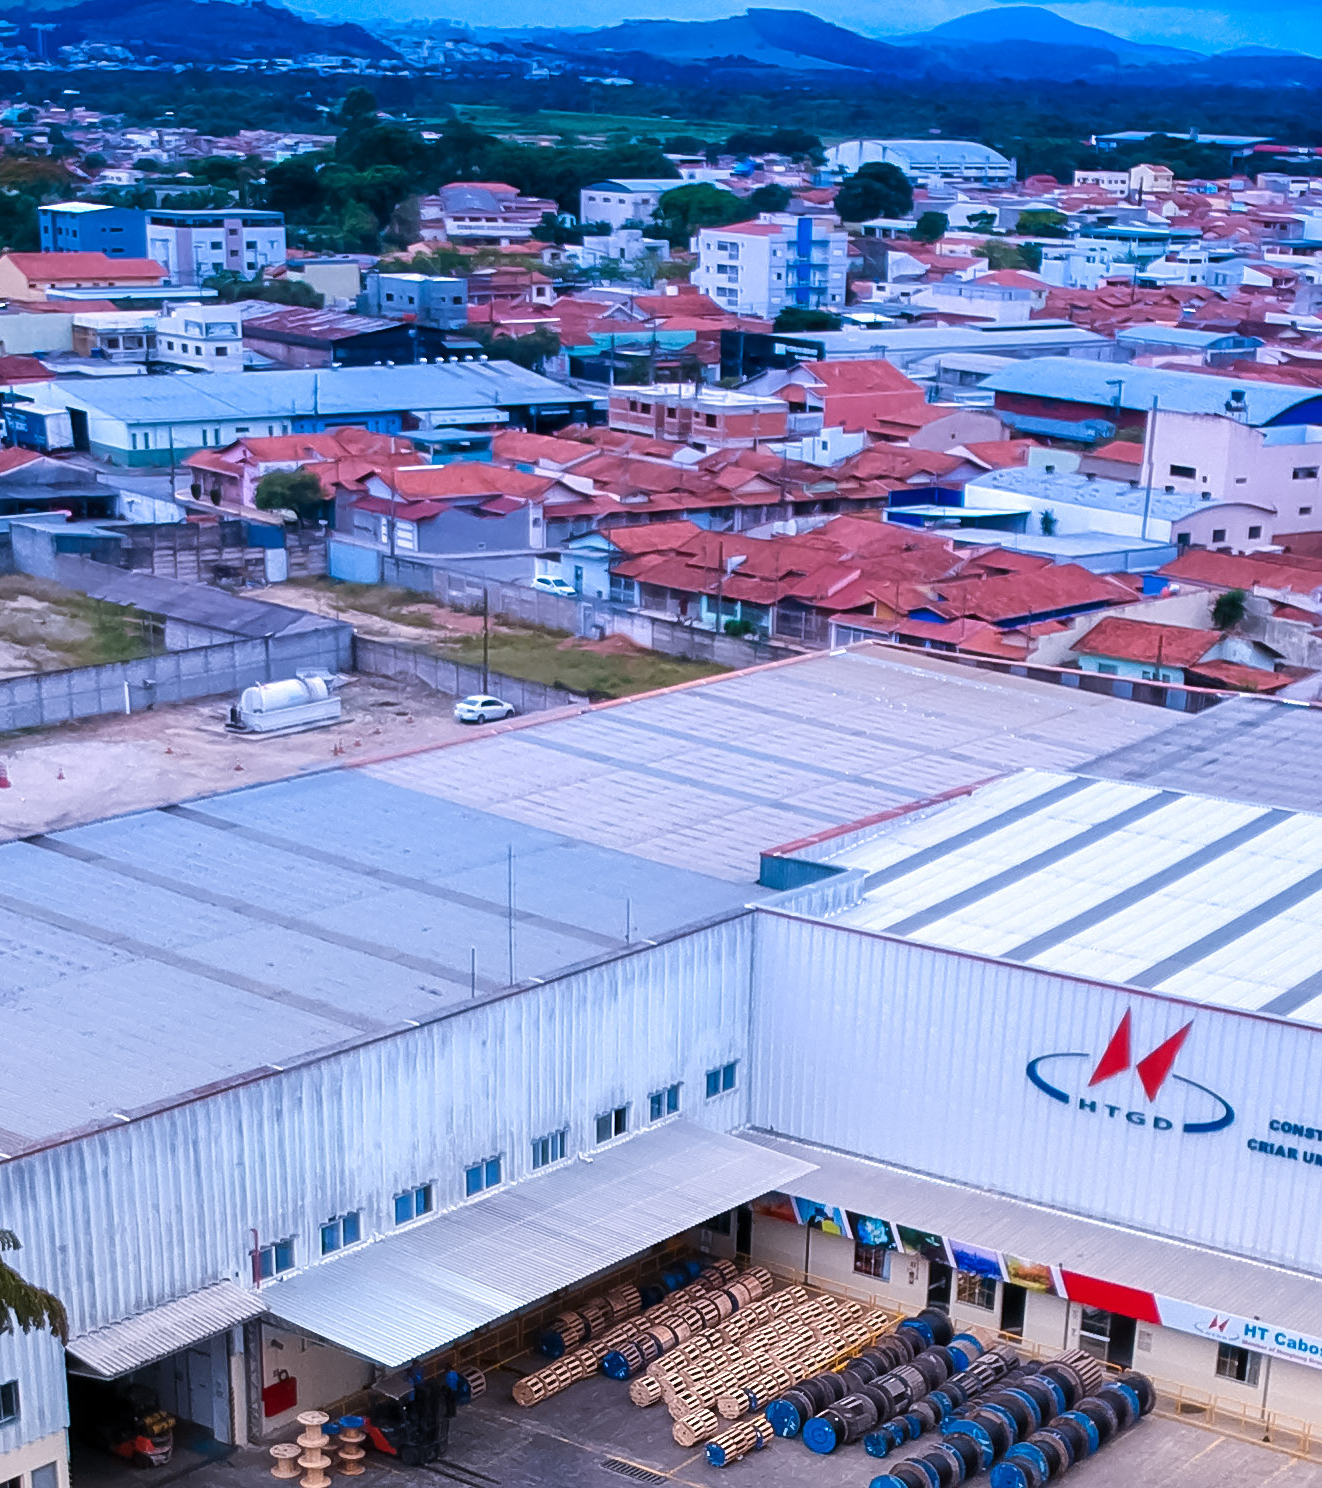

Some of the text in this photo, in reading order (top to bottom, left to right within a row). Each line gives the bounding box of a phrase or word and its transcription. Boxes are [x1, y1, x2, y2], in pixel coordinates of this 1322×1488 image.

[1078, 1098, 1173, 1131] HTGD
[1247, 1138, 1299, 1161] CRIAR
[1244, 1323, 1269, 1341] HT
